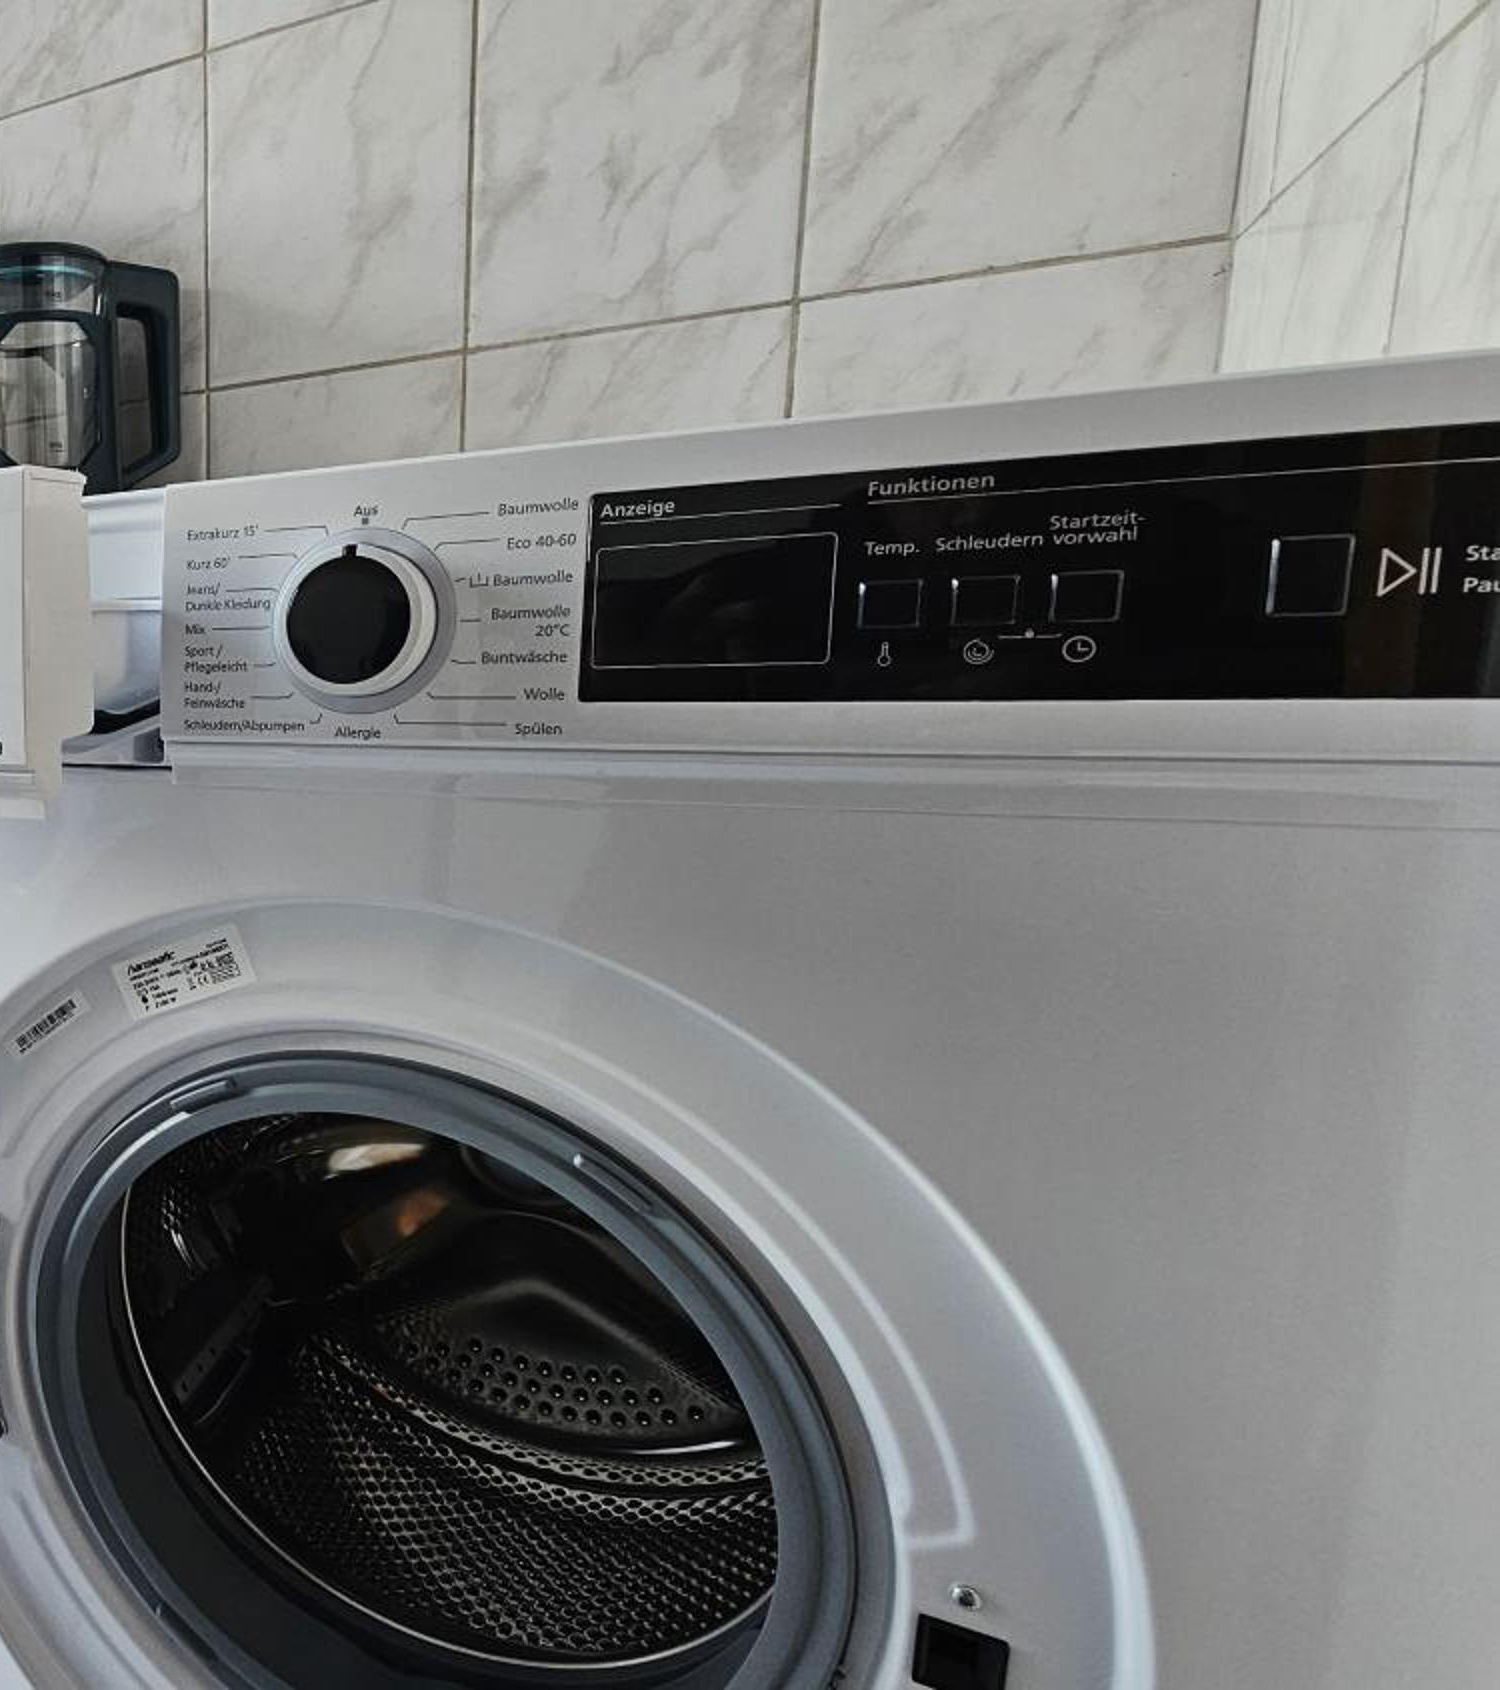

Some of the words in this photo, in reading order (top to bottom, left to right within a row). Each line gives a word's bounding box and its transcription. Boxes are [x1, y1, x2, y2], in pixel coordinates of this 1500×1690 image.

[867, 475, 996, 497] Funktionen
[354, 505, 379, 517] Aus
[498, 498, 579, 516] Baumwolle
[600, 500, 676, 519] Anzeige
[1050, 509, 1148, 531] Startzeit-
[187, 528, 240, 541] Extrakurz
[507, 537, 531, 550] Eco
[535, 533, 577, 548] 40-60
[1053, 526, 1138, 546] vorwahl
[864, 540, 920, 557] Temp.
[934, 533, 1044, 552] Schleudern
[187, 559, 211, 570] Kurz
[493, 569, 574, 586] Baumwolle
[491, 605, 571, 620] Baumwolle
[185, 624, 205, 635] Mix
[535, 624, 570, 637] 20°C
[481, 650, 568, 664] Buntwäsche
[185, 660, 248, 674] Pflegeleicht
[524, 688, 565, 701] Wolle
[184, 698, 245, 709] Feinwäsche
[334, 726, 381, 741] Allergie
[515, 722, 563, 737] Spülen
